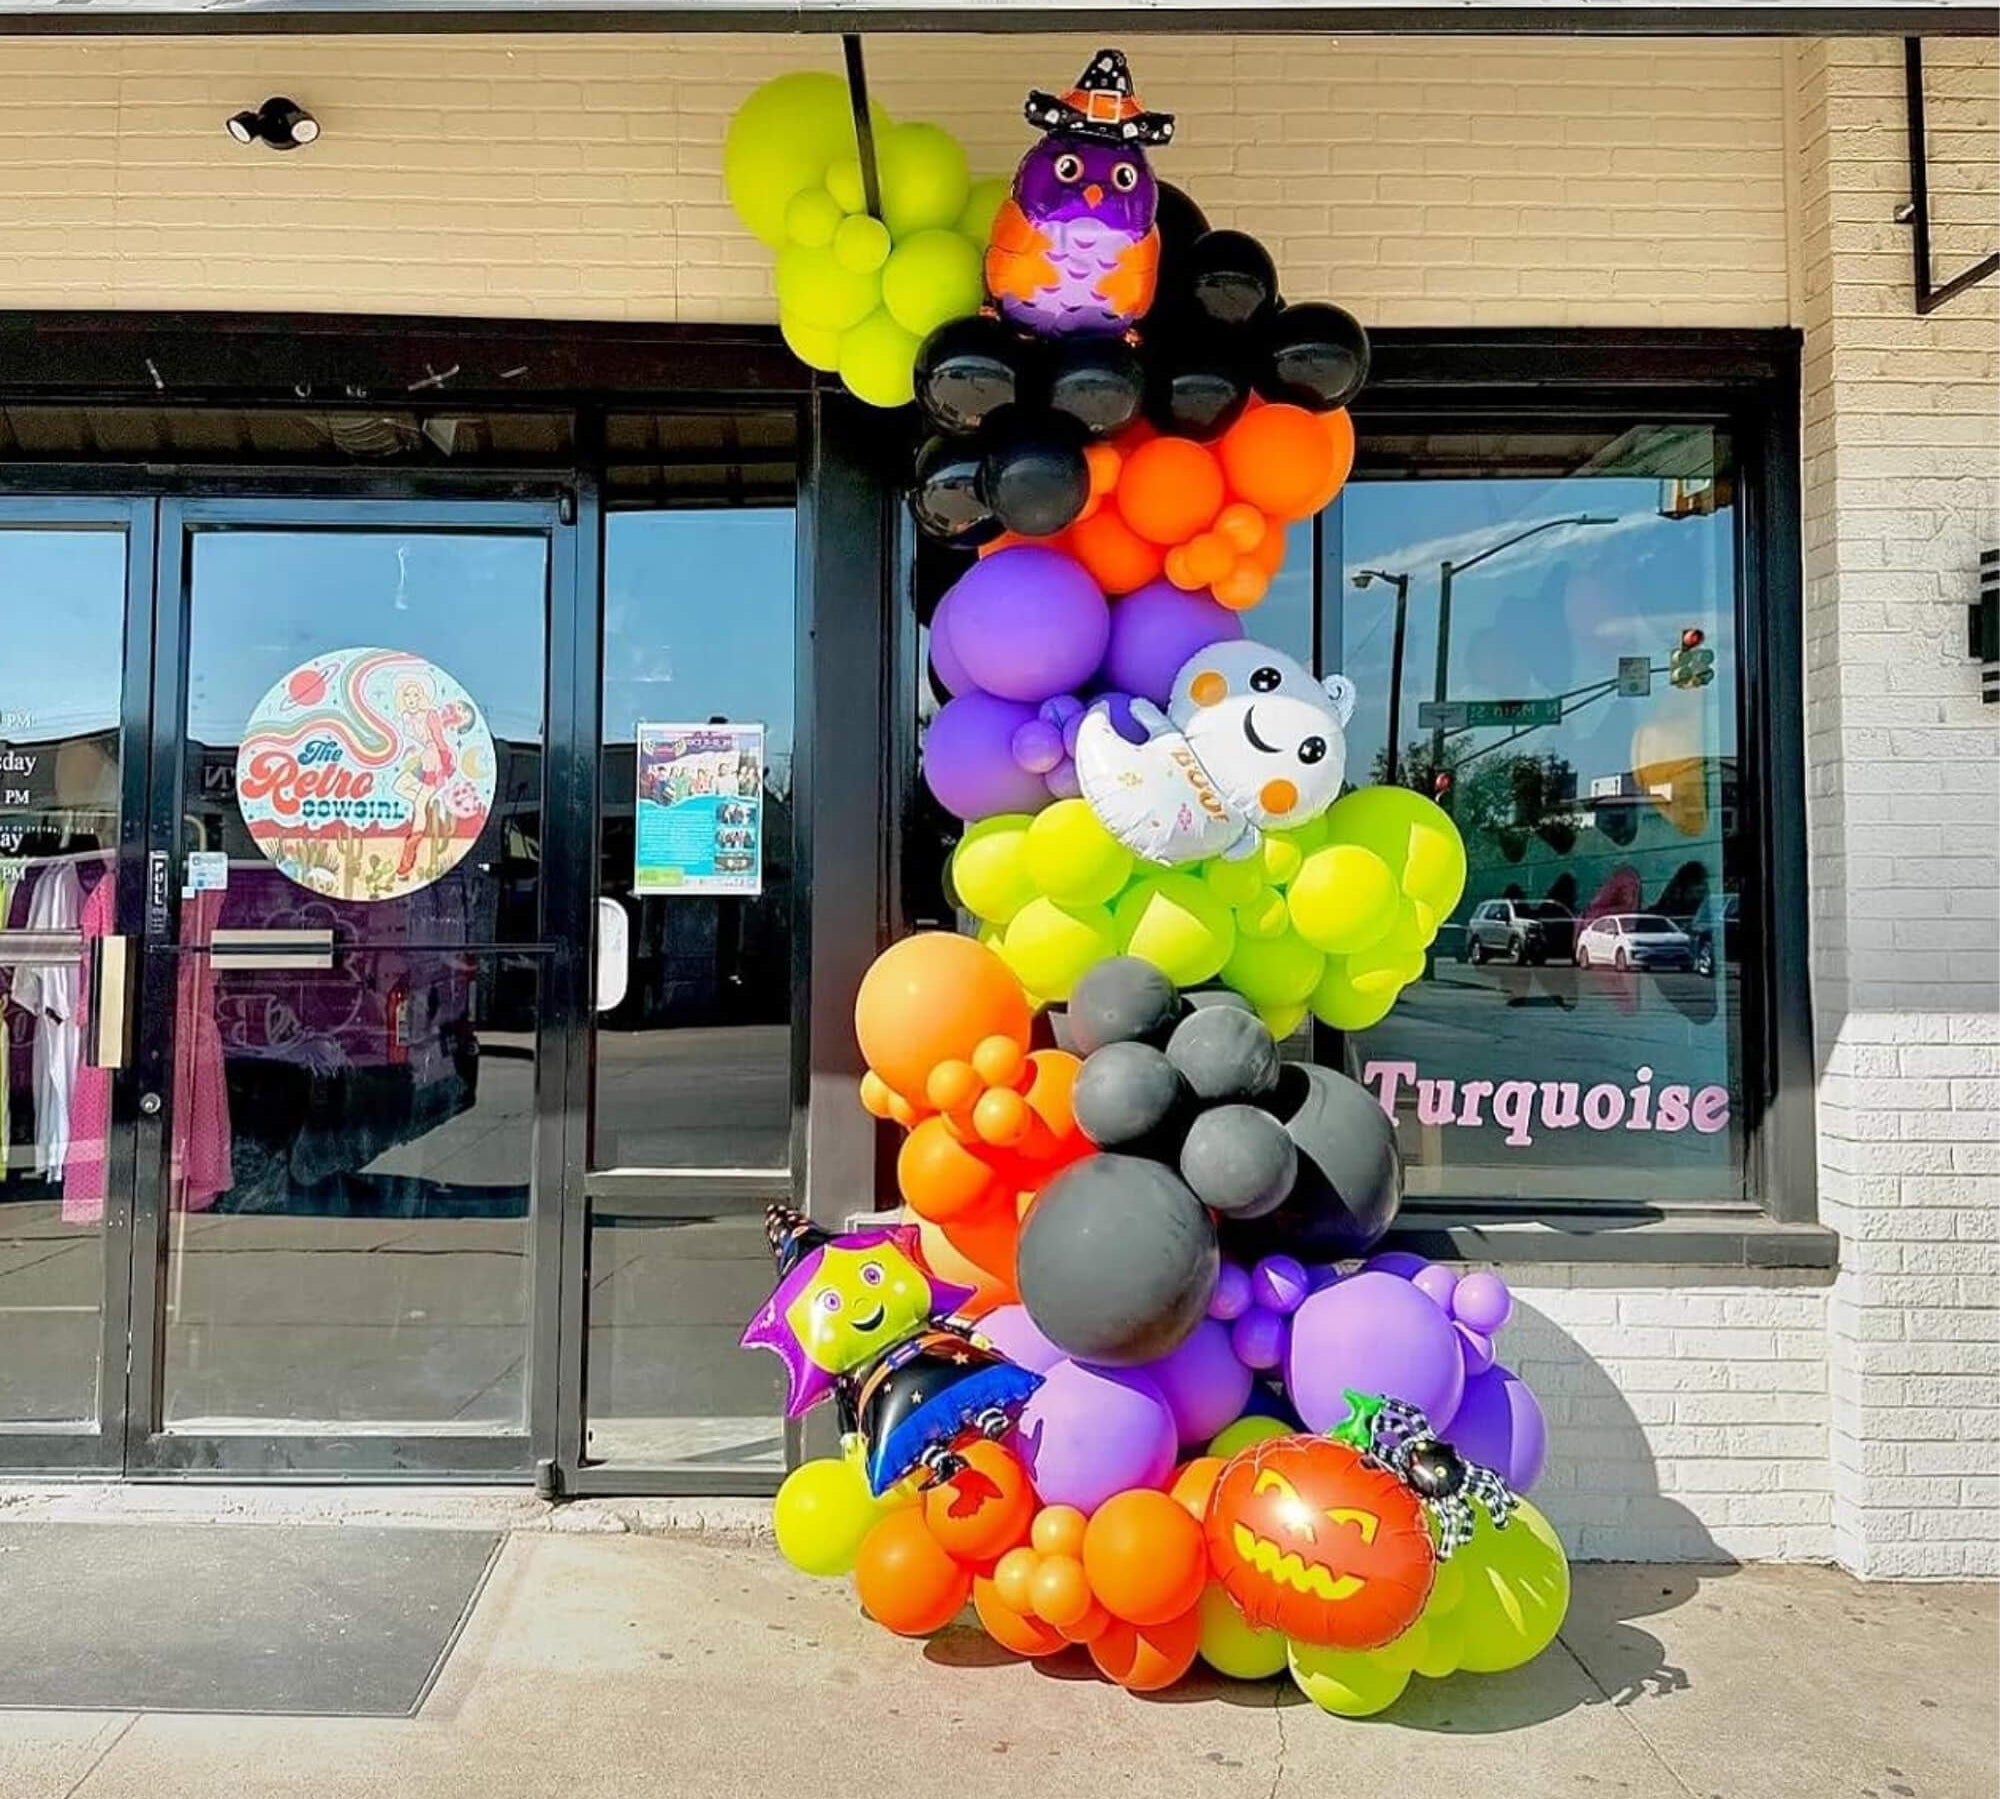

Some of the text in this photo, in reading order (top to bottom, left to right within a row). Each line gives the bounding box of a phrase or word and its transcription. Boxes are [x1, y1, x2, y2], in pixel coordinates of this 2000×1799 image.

[298, 740, 343, 765] The
[240, 751, 373, 815] Retro
[5, 789, 30, 804] PM
[302, 801, 405, 819] COWGIRL
[3, 867, 26, 881] PM
[154, 861, 165, 906] PULL
[1363, 1061, 1731, 1146] Turquoise
